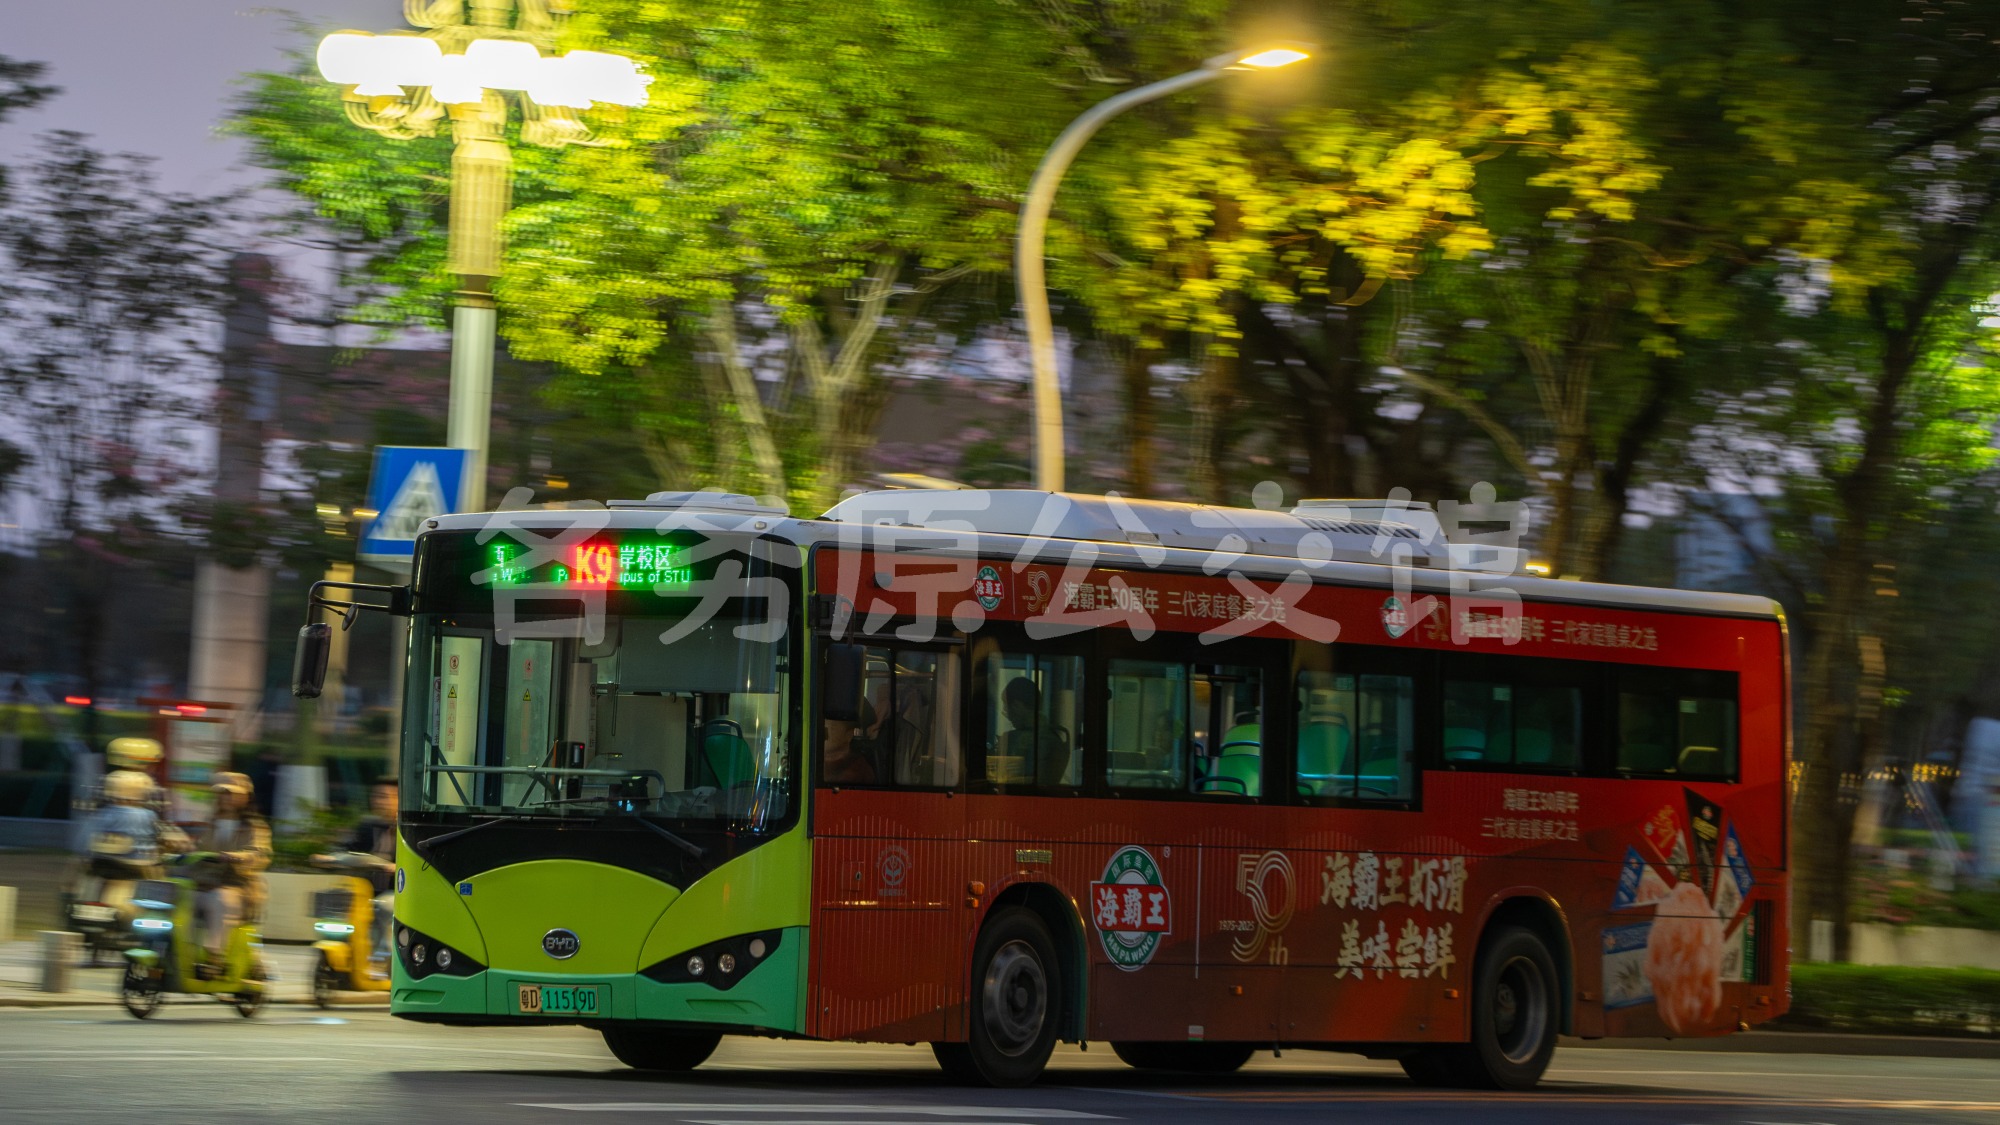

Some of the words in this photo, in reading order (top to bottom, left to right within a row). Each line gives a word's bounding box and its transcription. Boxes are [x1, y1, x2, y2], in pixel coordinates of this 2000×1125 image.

[576, 546, 612, 583] K9
[649, 571, 661, 583] of
[664, 570, 690, 583] STU
[1064, 581, 1159, 614] 海霸王50周年
[1167, 591, 1286, 623] 三代家庭餐桌之选
[1321, 850, 1468, 914] 海霸王虾滑
[1097, 887, 1164, 928] 海霸王
[546, 937, 575, 950] BYD
[1269, 935, 1288, 966] th
[1334, 918, 1456, 980] 美味尝鲜
